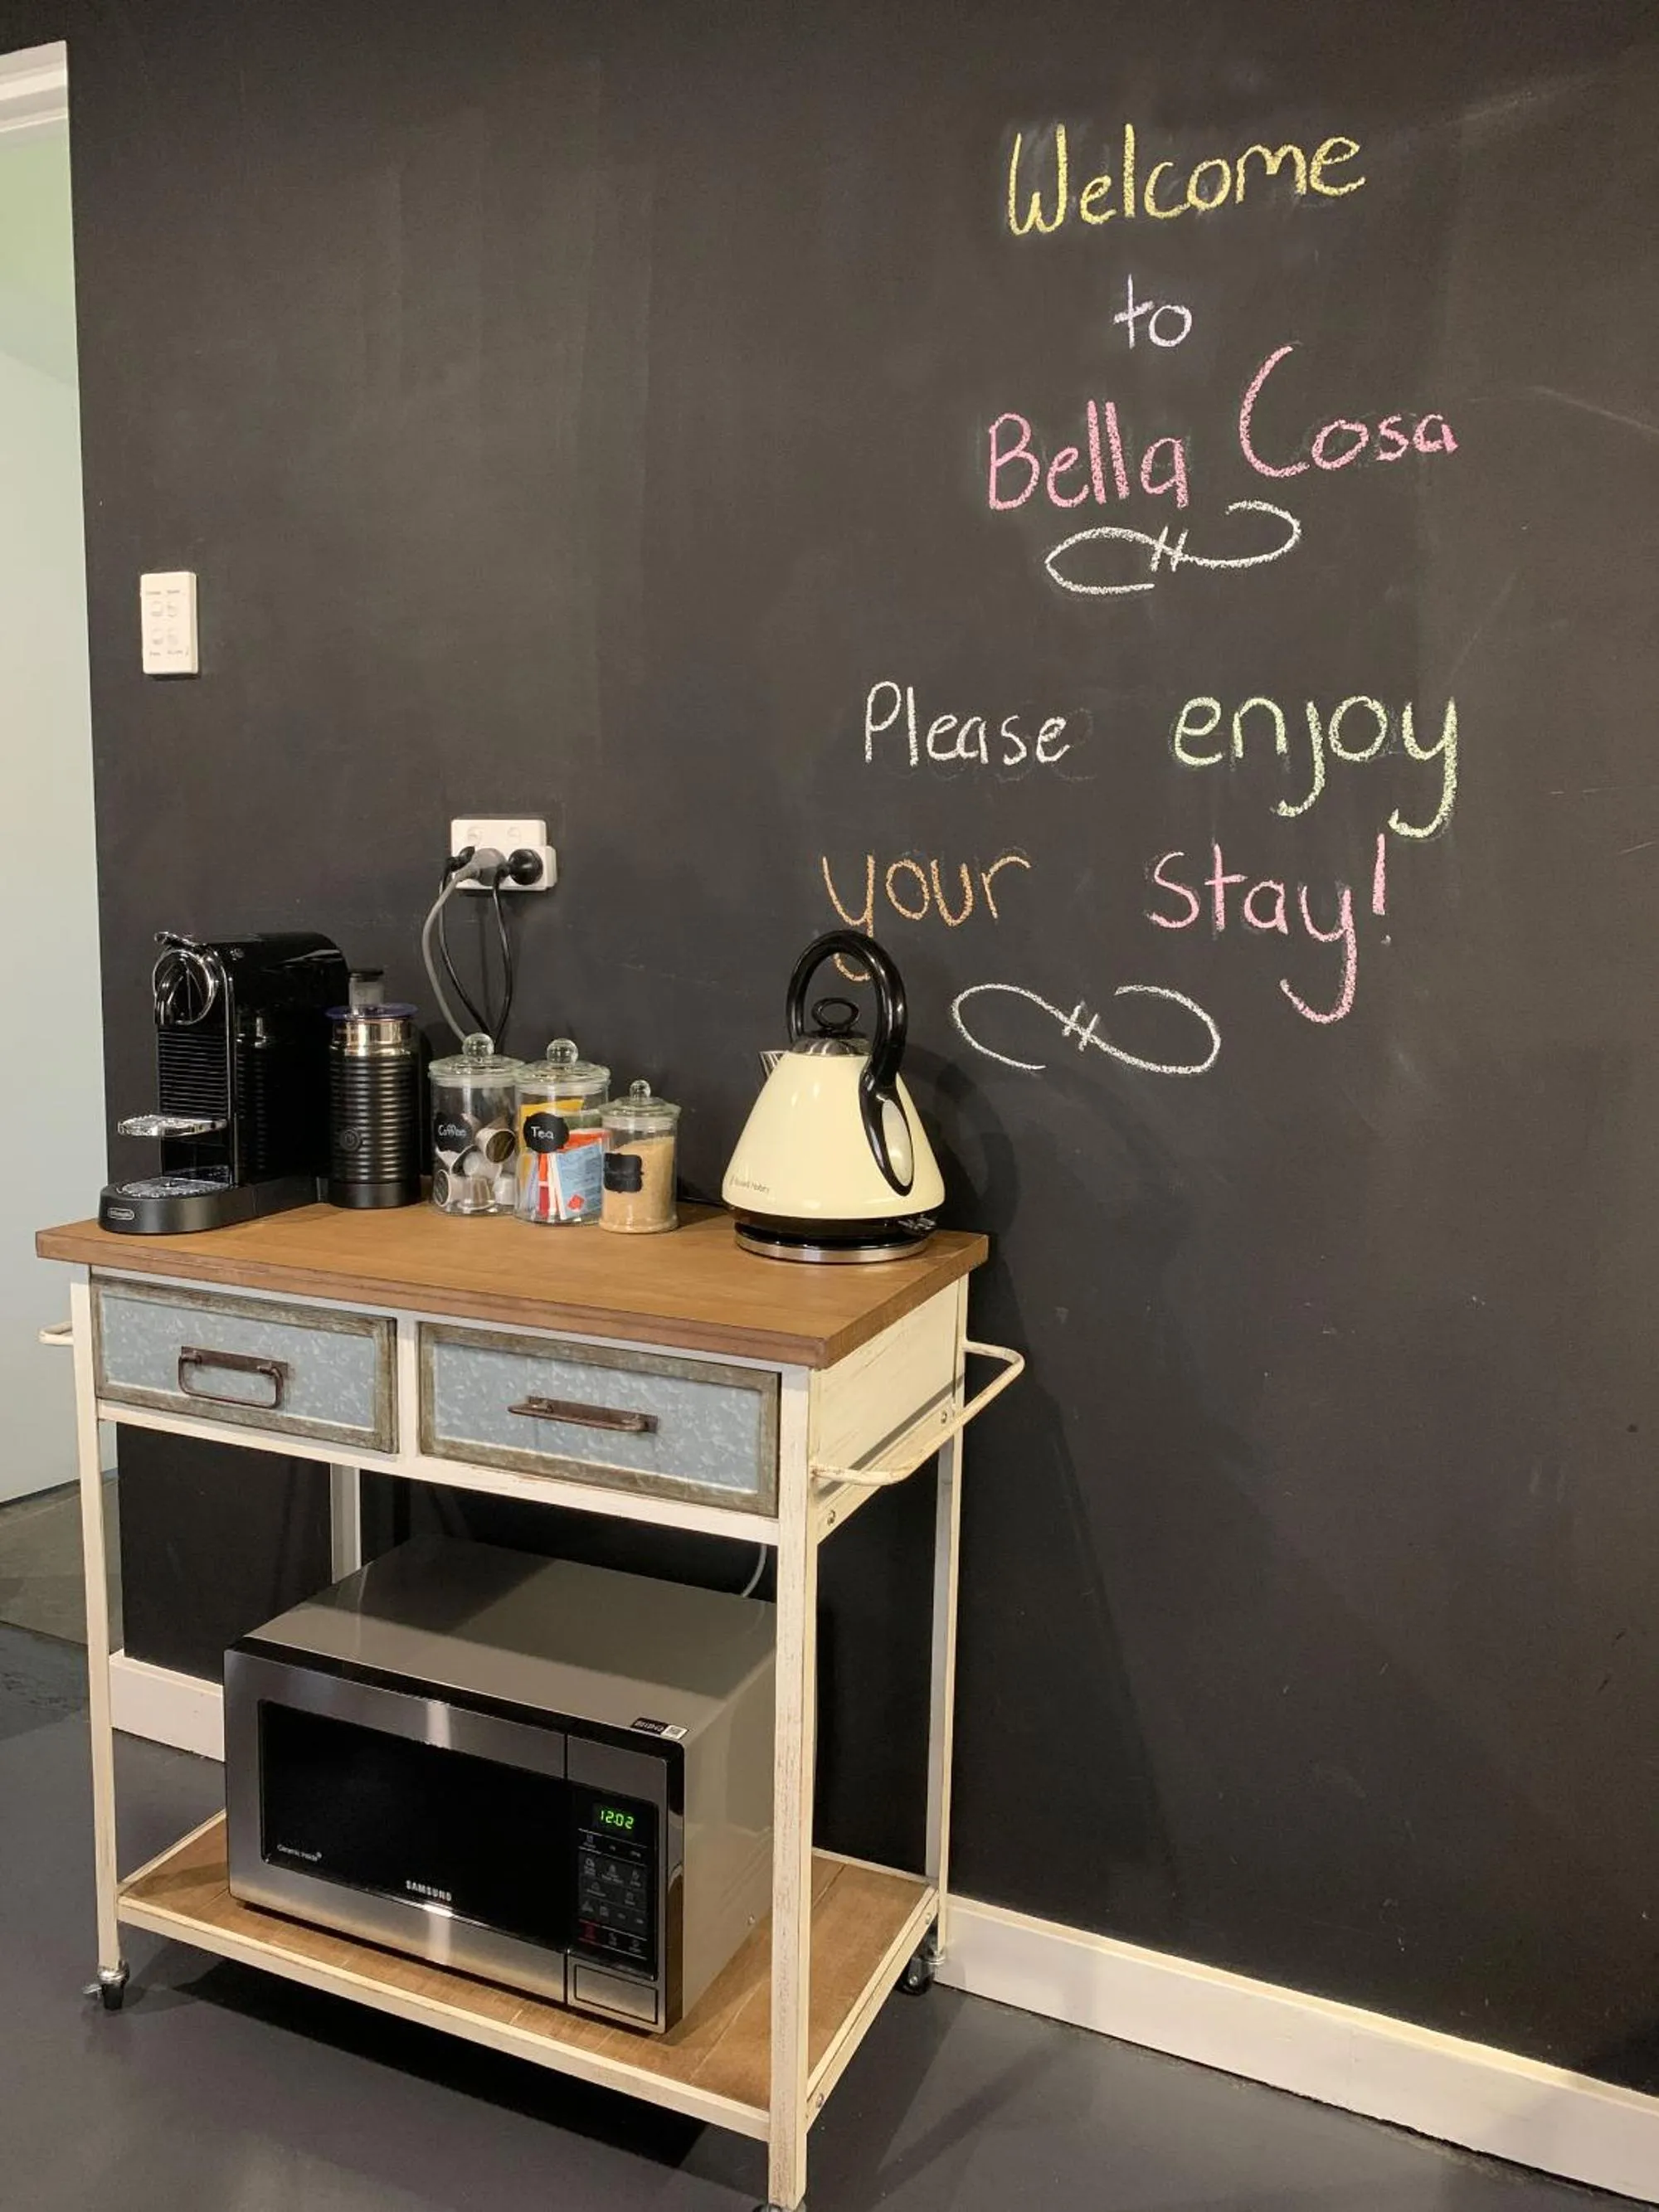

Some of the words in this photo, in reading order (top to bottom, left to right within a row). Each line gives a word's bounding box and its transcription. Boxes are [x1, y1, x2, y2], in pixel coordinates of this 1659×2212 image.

[1007, 123, 1367, 236] Welcome
[1112, 273, 1193, 348] to
[988, 400, 1190, 511] Bella
[1239, 343, 1459, 479] Cosa
[864, 680, 1073, 766] Please
[1174, 695, 1458, 838] enjoy
[821, 853, 1032, 982] your
[530, 1125, 555, 1140] Tea
